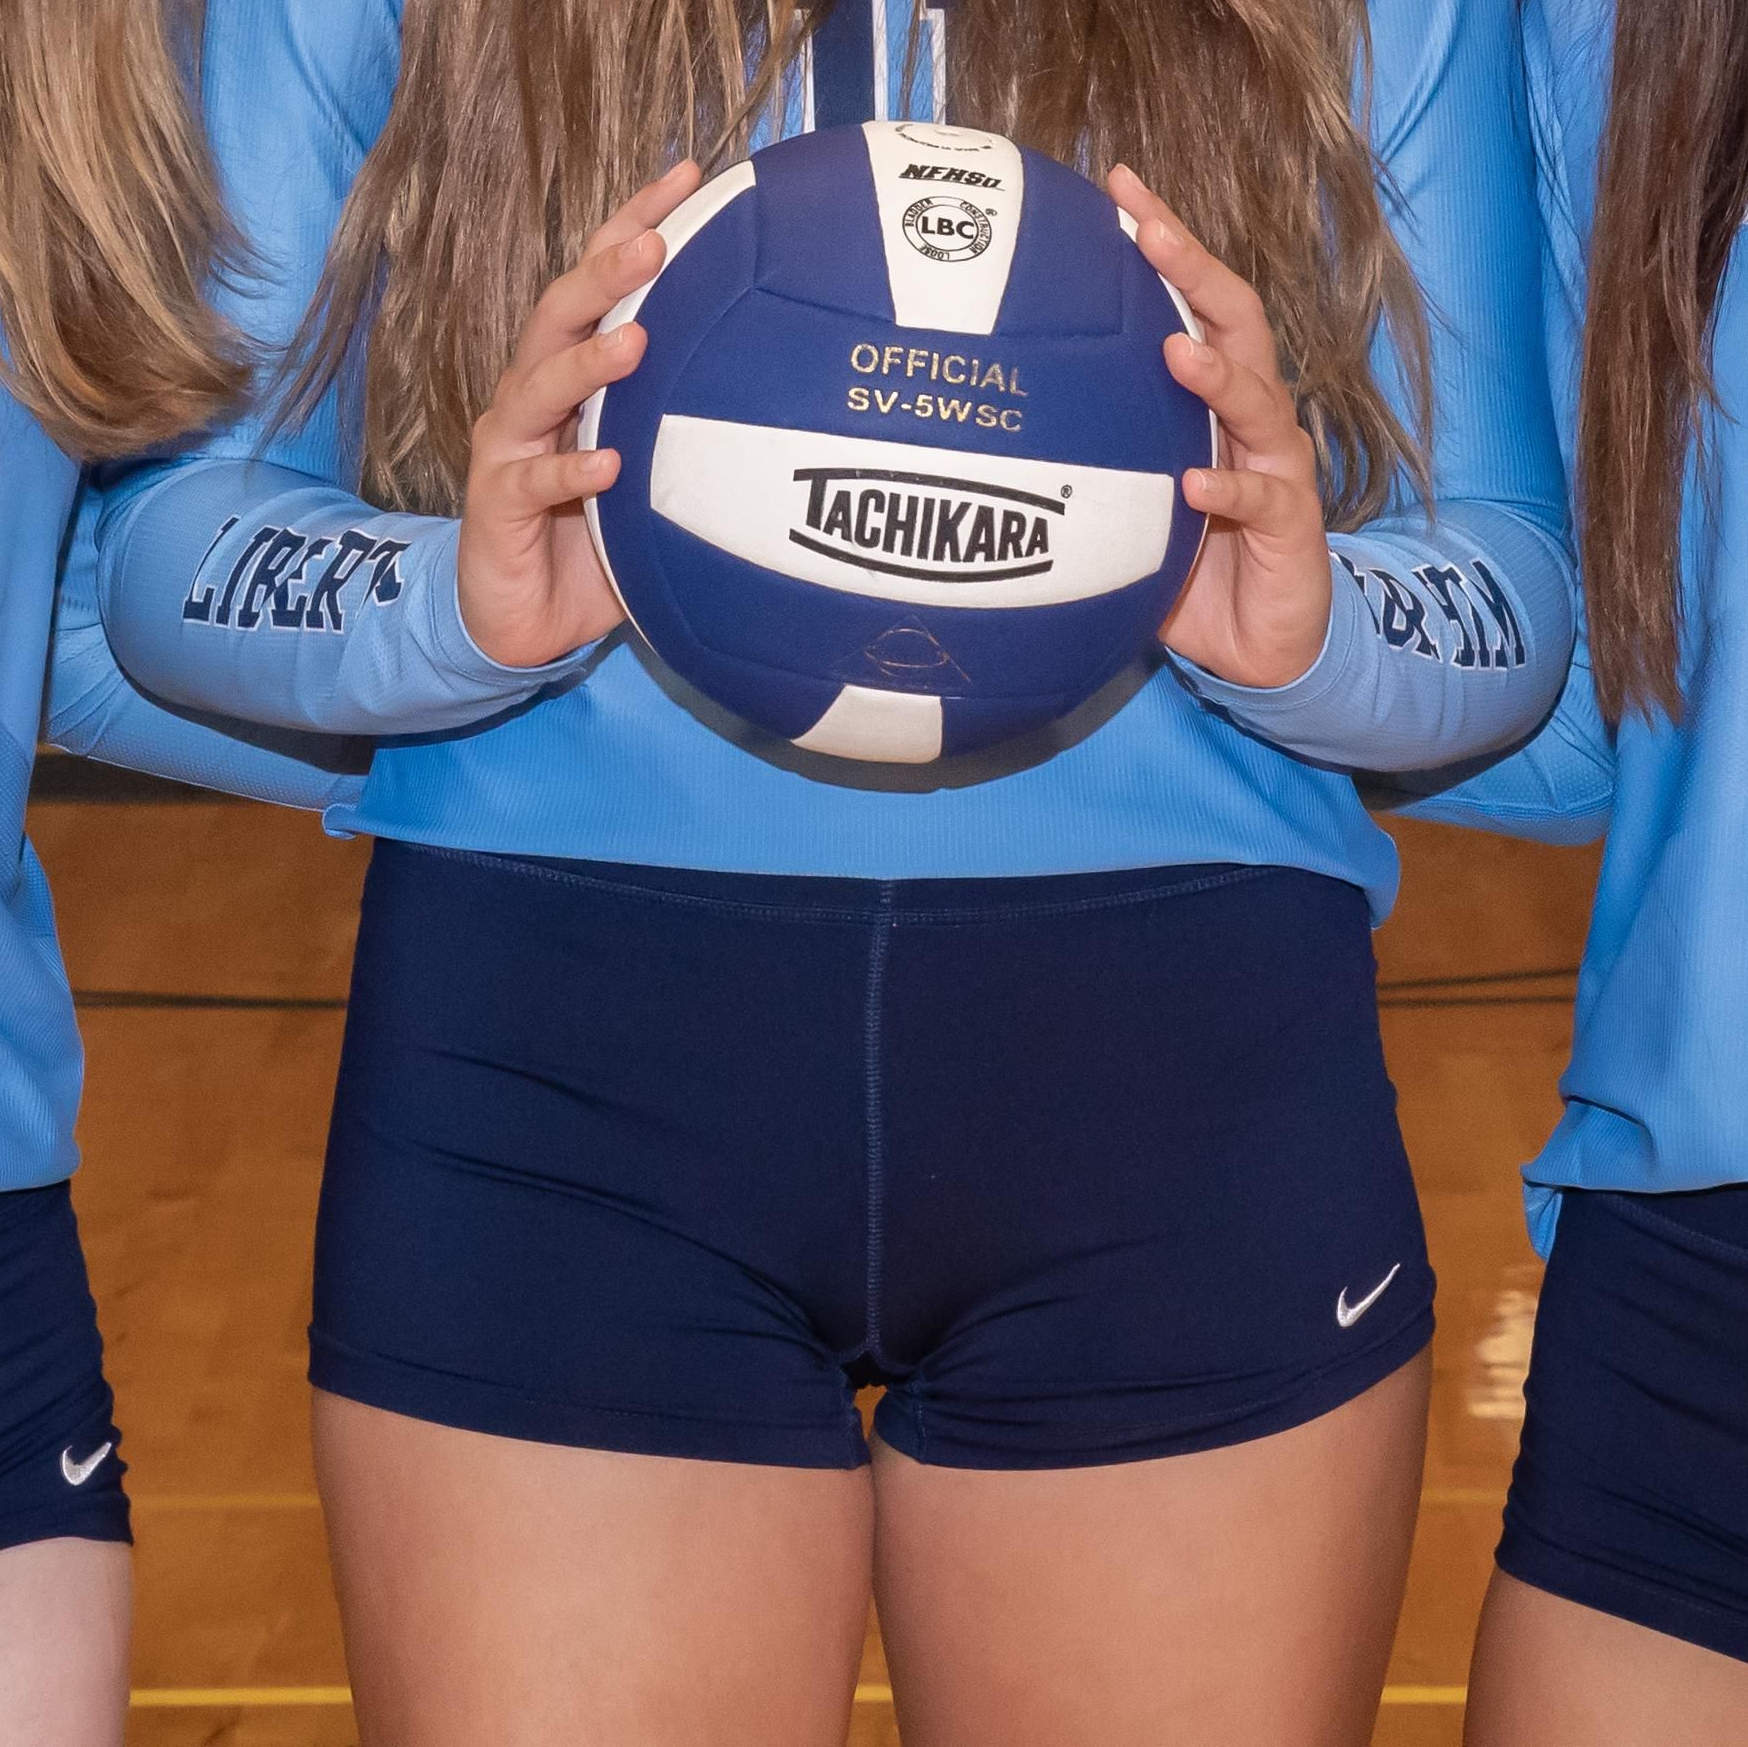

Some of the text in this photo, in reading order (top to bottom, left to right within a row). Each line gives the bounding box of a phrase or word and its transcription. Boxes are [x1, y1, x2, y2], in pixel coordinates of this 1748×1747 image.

[921, 215, 974, 240] LBC
[851, 343, 1029, 397] OFFICIAL
[847, 387, 1023, 433] SV-5WSC
